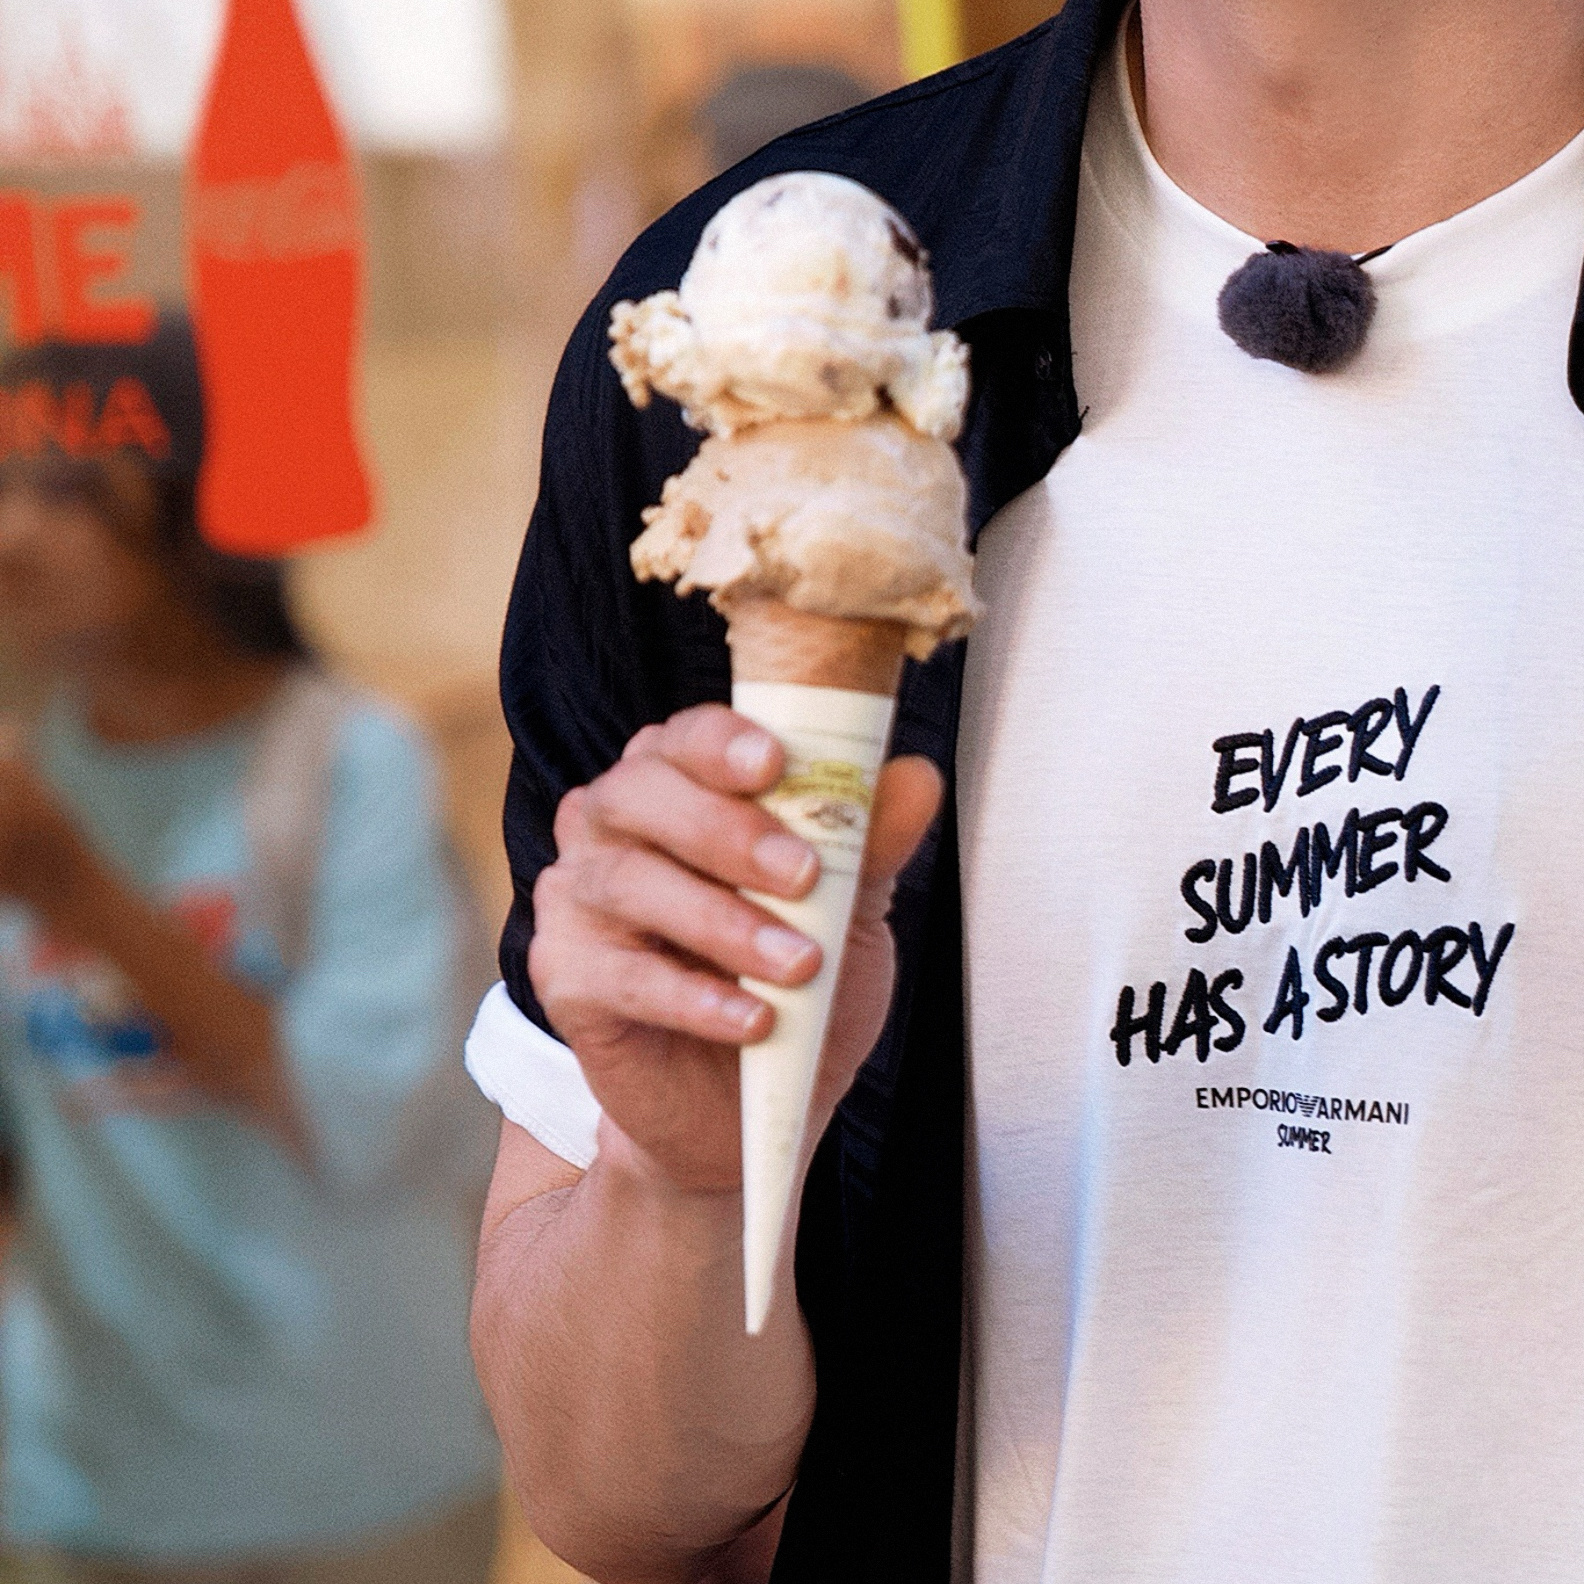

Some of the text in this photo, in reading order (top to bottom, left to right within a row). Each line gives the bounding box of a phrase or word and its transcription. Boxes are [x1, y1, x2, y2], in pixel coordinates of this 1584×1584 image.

[1210, 684, 1440, 814] EVERY
[1180, 801, 1451, 943] SUMMER
[1110, 967, 1246, 1067] HAS
[1313, 921, 1515, 1022] STORY
[1195, 1087, 1410, 1125] EMPORIO ARMANI
[1276, 1122, 1333, 1155] SUMMER
